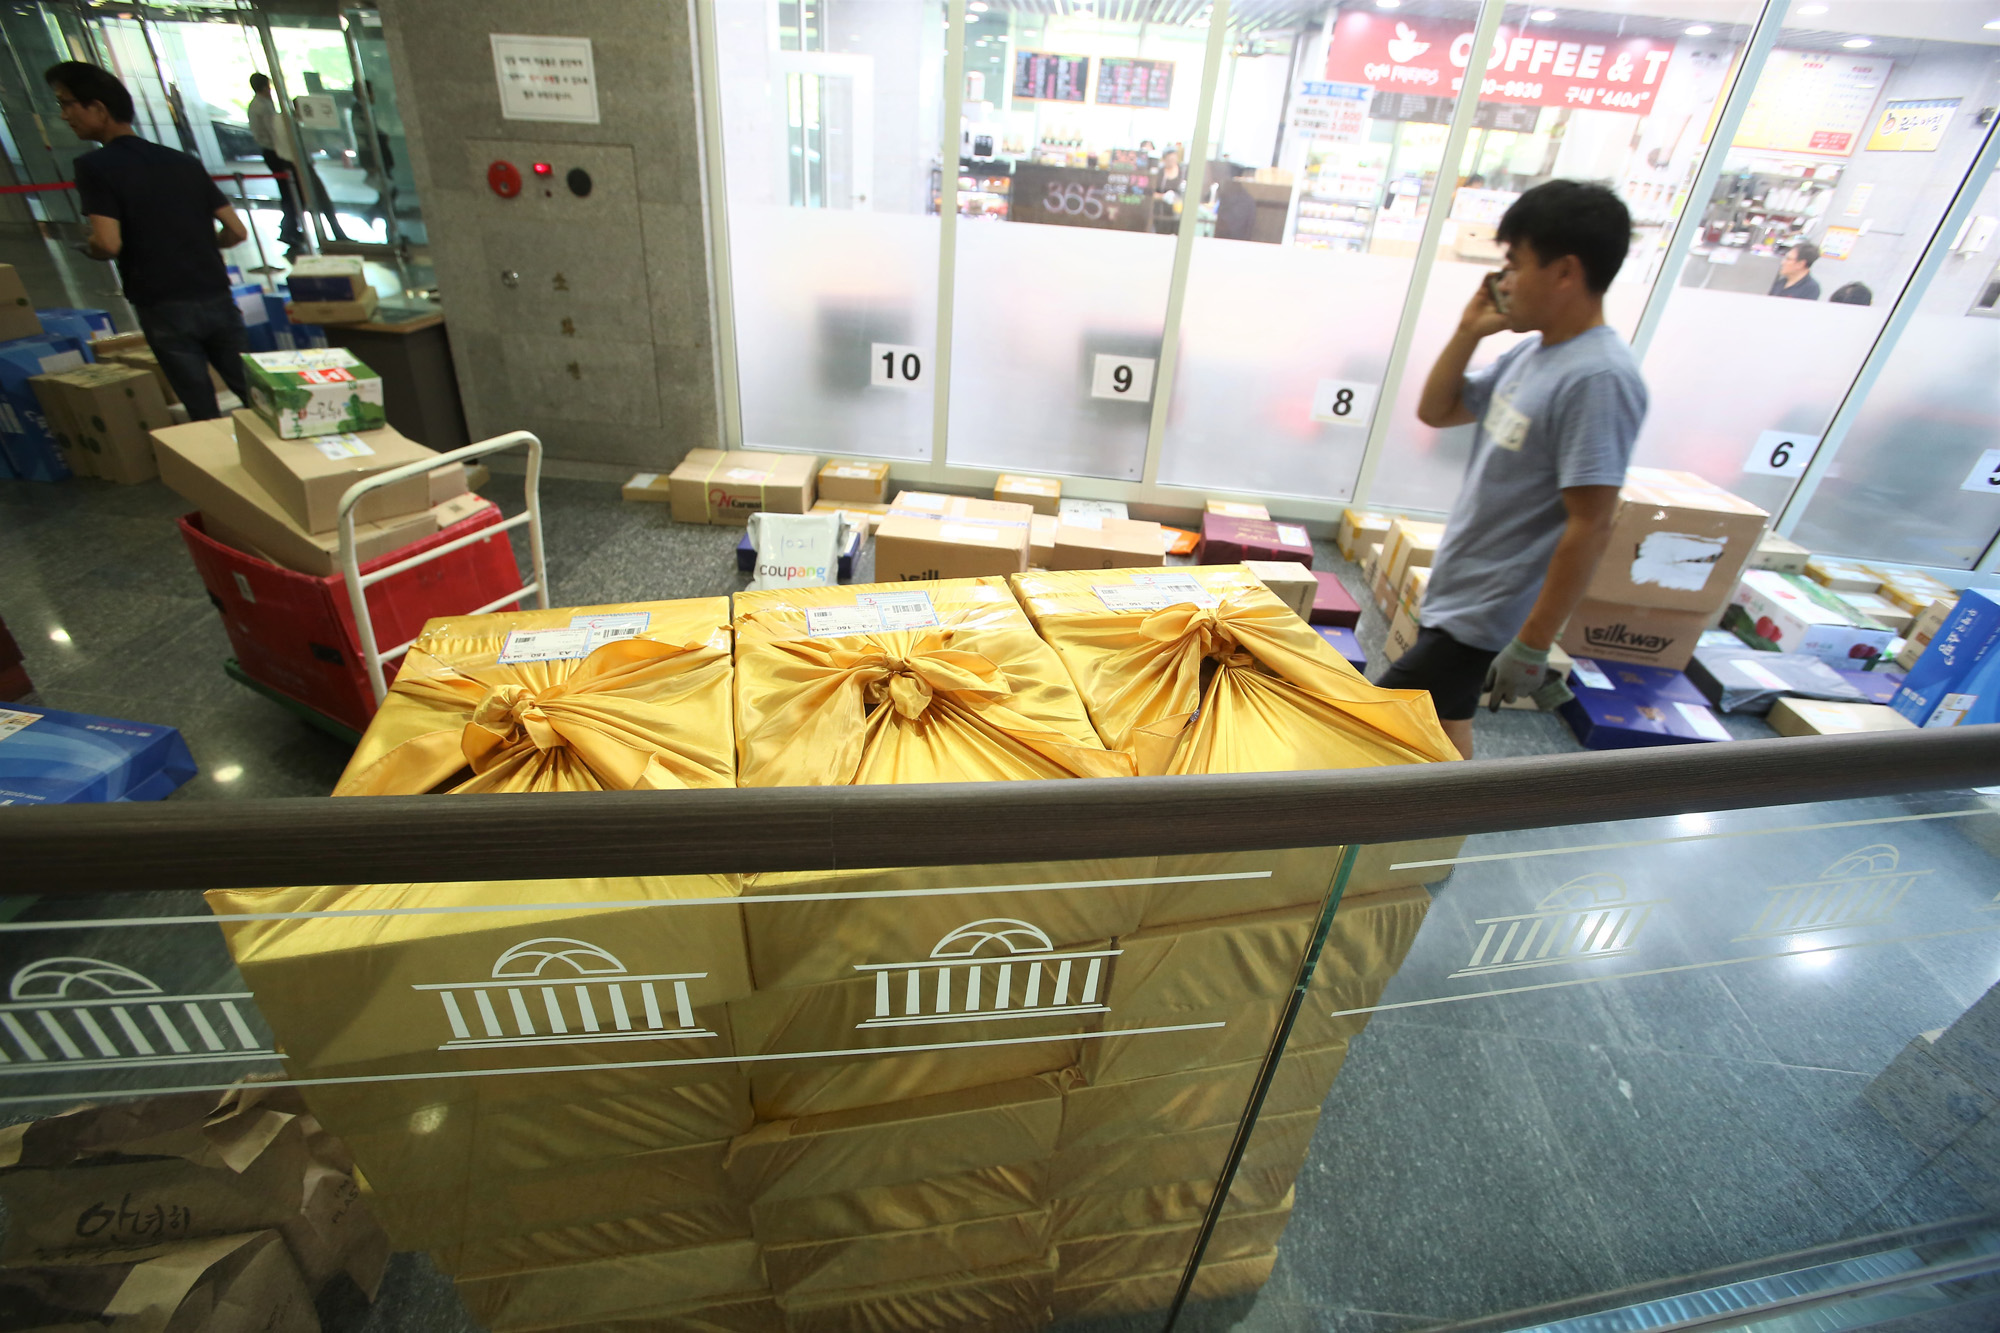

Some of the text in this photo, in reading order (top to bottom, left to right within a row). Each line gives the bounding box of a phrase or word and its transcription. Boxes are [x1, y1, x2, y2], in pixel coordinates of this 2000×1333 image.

[1606, 52, 1634, 82] &
[1642, 50, 1670, 84] T
[1043, 181, 1104, 220] 365
[882, 351, 921, 381] 10
[1113, 364, 1133, 393] 9
[1332, 388, 1354, 416] 8
[1769, 441, 1794, 468] 6
[760, 564, 827, 581] coupang
[1586, 623, 1674, 653] silkway
